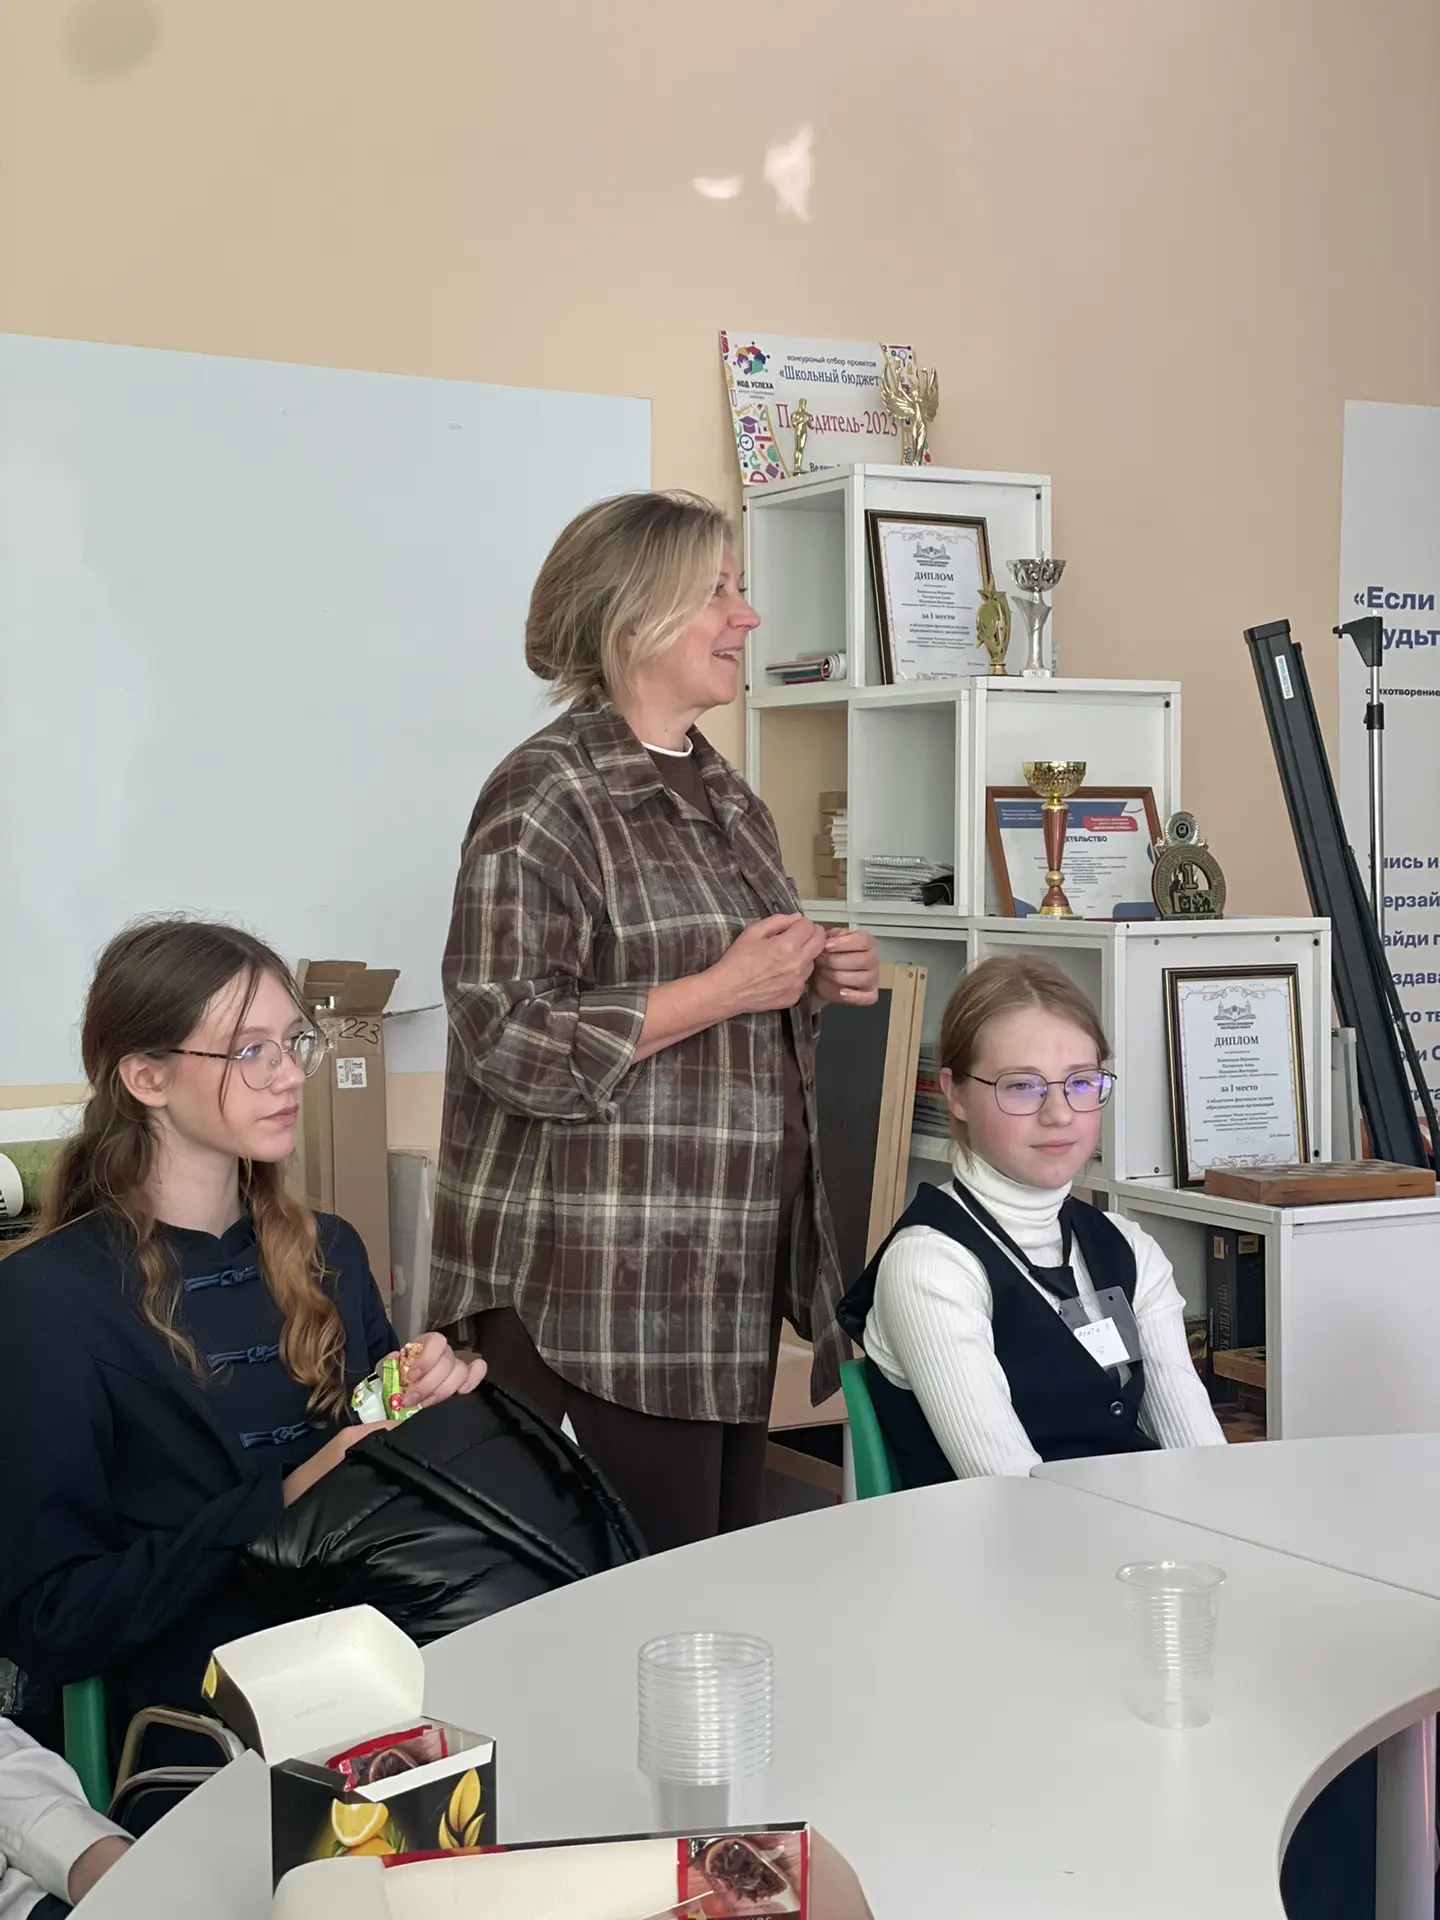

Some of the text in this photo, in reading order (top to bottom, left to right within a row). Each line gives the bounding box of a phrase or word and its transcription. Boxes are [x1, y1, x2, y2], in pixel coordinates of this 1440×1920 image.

[780, 365, 839, 383] «Школьный
[750, 381, 774, 390] УСПЕХА
[776, 404, 898, 437] Педитель-2023
[914, 572, 954, 582] ДИПЛОМ
[1354, 586, 1435, 611] «Если
[1383, 628, 1440, 650] удьт
[1065, 835, 1108, 844] ЕТЕЛЬСТВО
[1383, 891, 1440, 911] ерзай
[1384, 930, 1429, 949] айди
[1392, 972, 1440, 987] здав
[340, 1017, 380, 1044] 223
[1214, 1036, 1259, 1047] ДИПЛОМ
